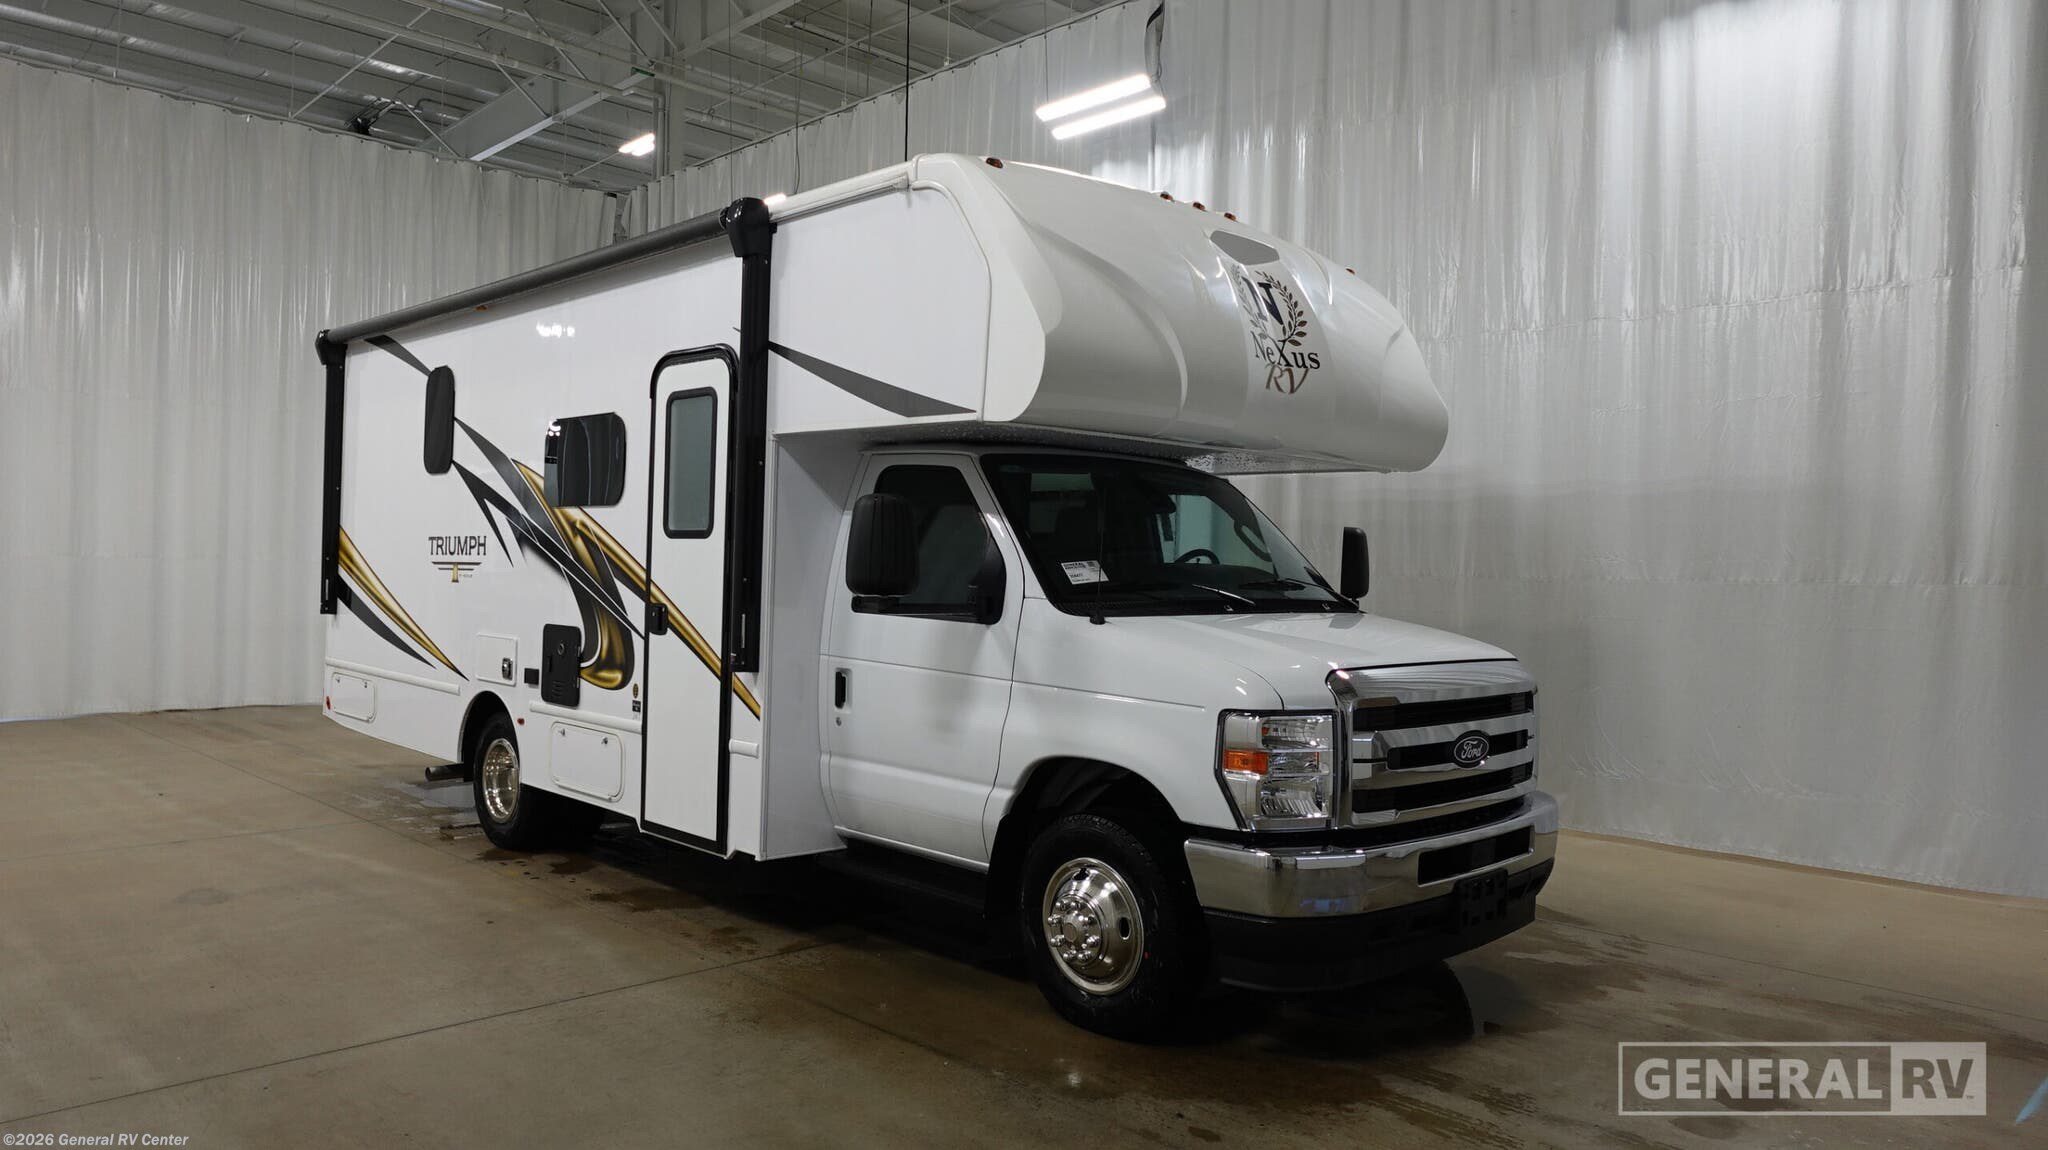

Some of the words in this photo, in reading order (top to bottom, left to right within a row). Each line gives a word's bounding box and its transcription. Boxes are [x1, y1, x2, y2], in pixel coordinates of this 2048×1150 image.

[1264, 363, 1310, 395] RV
[428, 535, 487, 556] TRIUMPH
[1461, 740, 1484, 759] Ford
